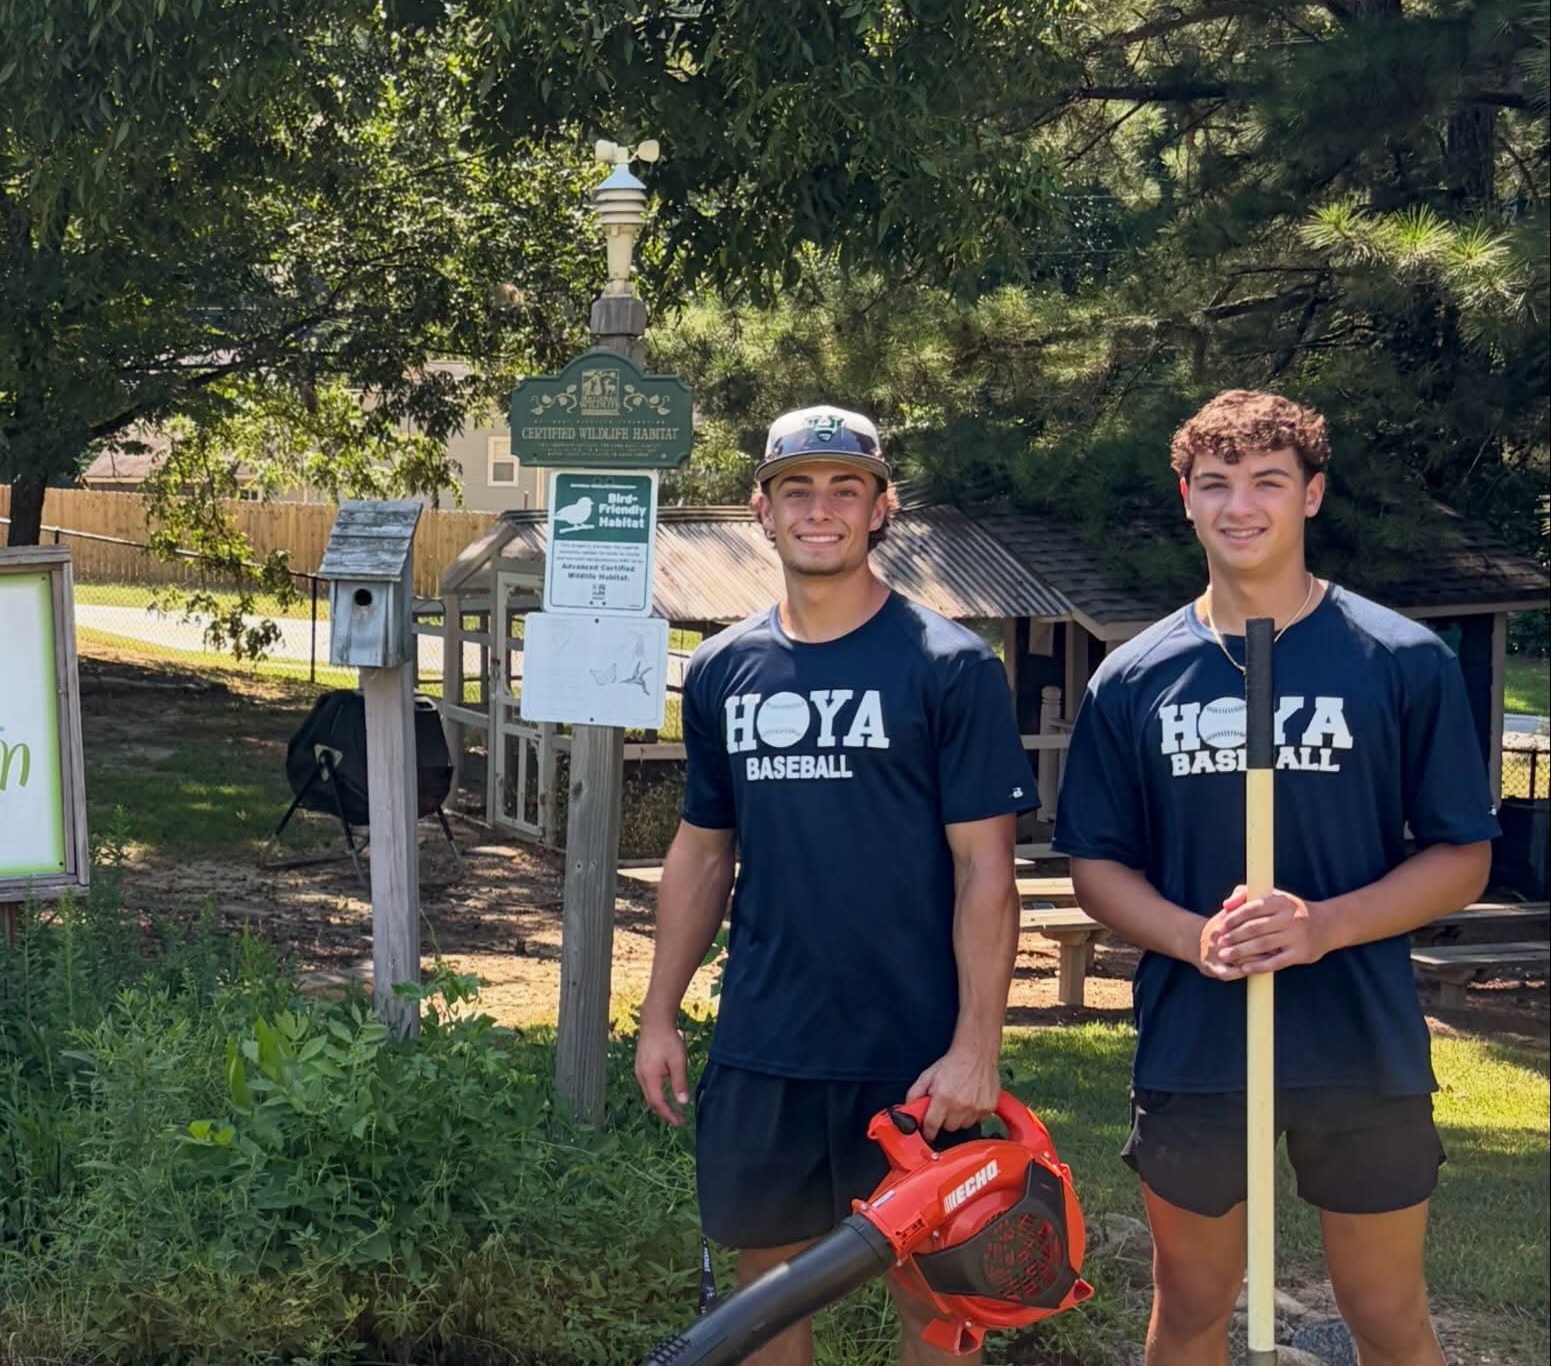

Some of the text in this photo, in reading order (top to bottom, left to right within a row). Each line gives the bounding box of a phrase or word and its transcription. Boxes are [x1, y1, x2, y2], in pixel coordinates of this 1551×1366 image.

[521, 426, 680, 441] CERTIFIED WILDLIFE HABITAT
[608, 493, 638, 504] Bird-
[599, 503, 647, 519] Friendly
[599, 516, 645, 529] Habitat
[724, 689, 890, 755] HOYA
[746, 754, 853, 781] BASEBALL
[1170, 746, 1341, 777] BASALL
[954, 1159, 998, 1206] ECHO
